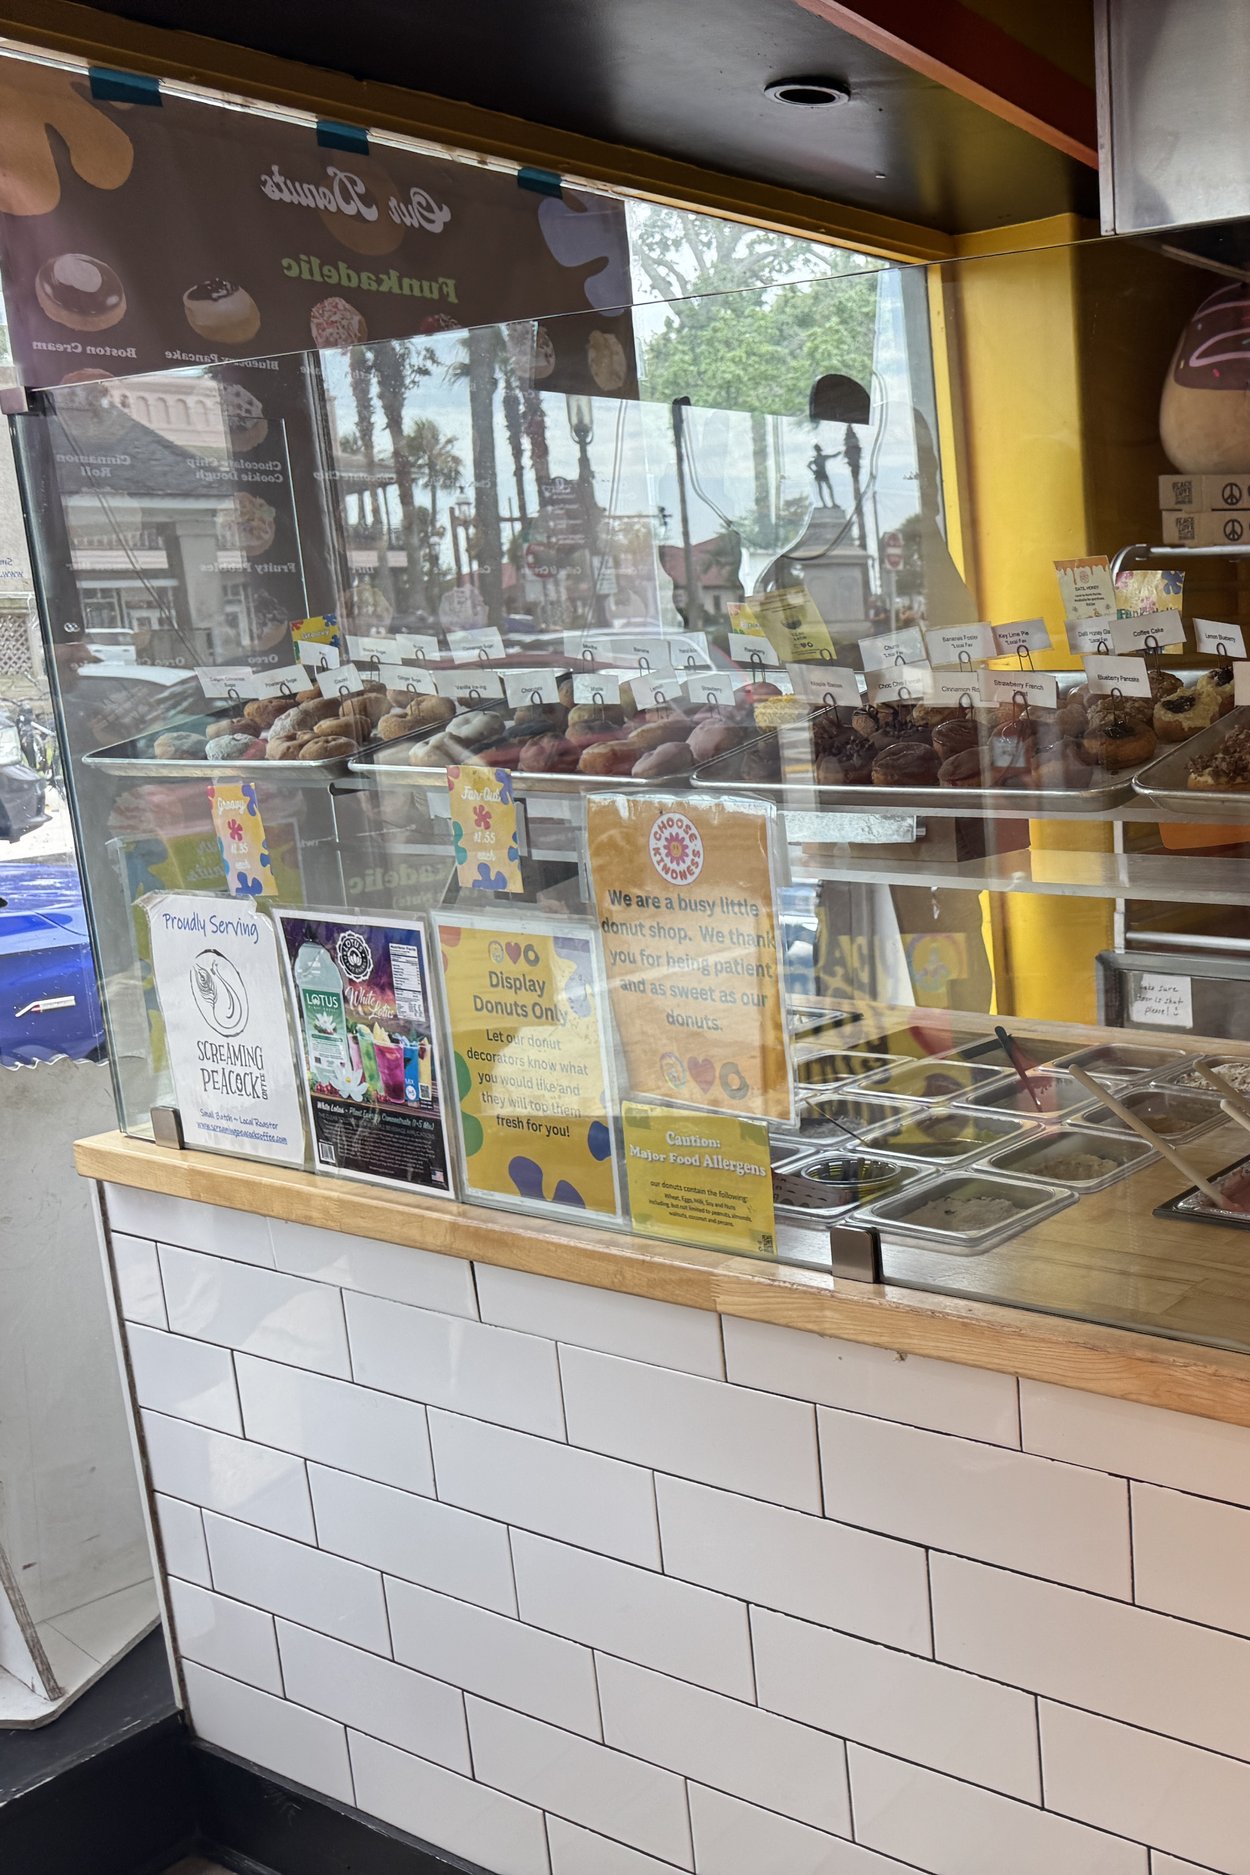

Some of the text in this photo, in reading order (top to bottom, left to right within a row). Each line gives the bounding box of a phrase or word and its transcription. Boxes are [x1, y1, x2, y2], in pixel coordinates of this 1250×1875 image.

[1133, 627, 1164, 637] Coffee Cake
[941, 685, 967, 693] Cinnamon
[993, 679, 1024, 690] Strawberry
[218, 797, 246, 816] Groovy
[654, 817, 697, 843] CHOOSE
[653, 847, 700, 880] KINDNESS
[608, 890, 760, 918] We are a busy little
[163, 912, 259, 945] Proudly Serving
[602, 917, 777, 950] donut shop. We thank
[488, 970, 546, 997] Display
[306, 992, 338, 1008] LOTUS
[473, 995, 569, 1027] Donuts Only
[197, 1040, 264, 1070] SCREAMING
[200, 1067, 260, 1099] PEACOCK
[666, 1131, 721, 1148] Caution:
[629, 1145, 766, 1178] Major Food Allergens
[662, 1181, 683, 1191] donuts
[684, 1185, 706, 1195] contain
[707, 1188, 718, 1197] the
